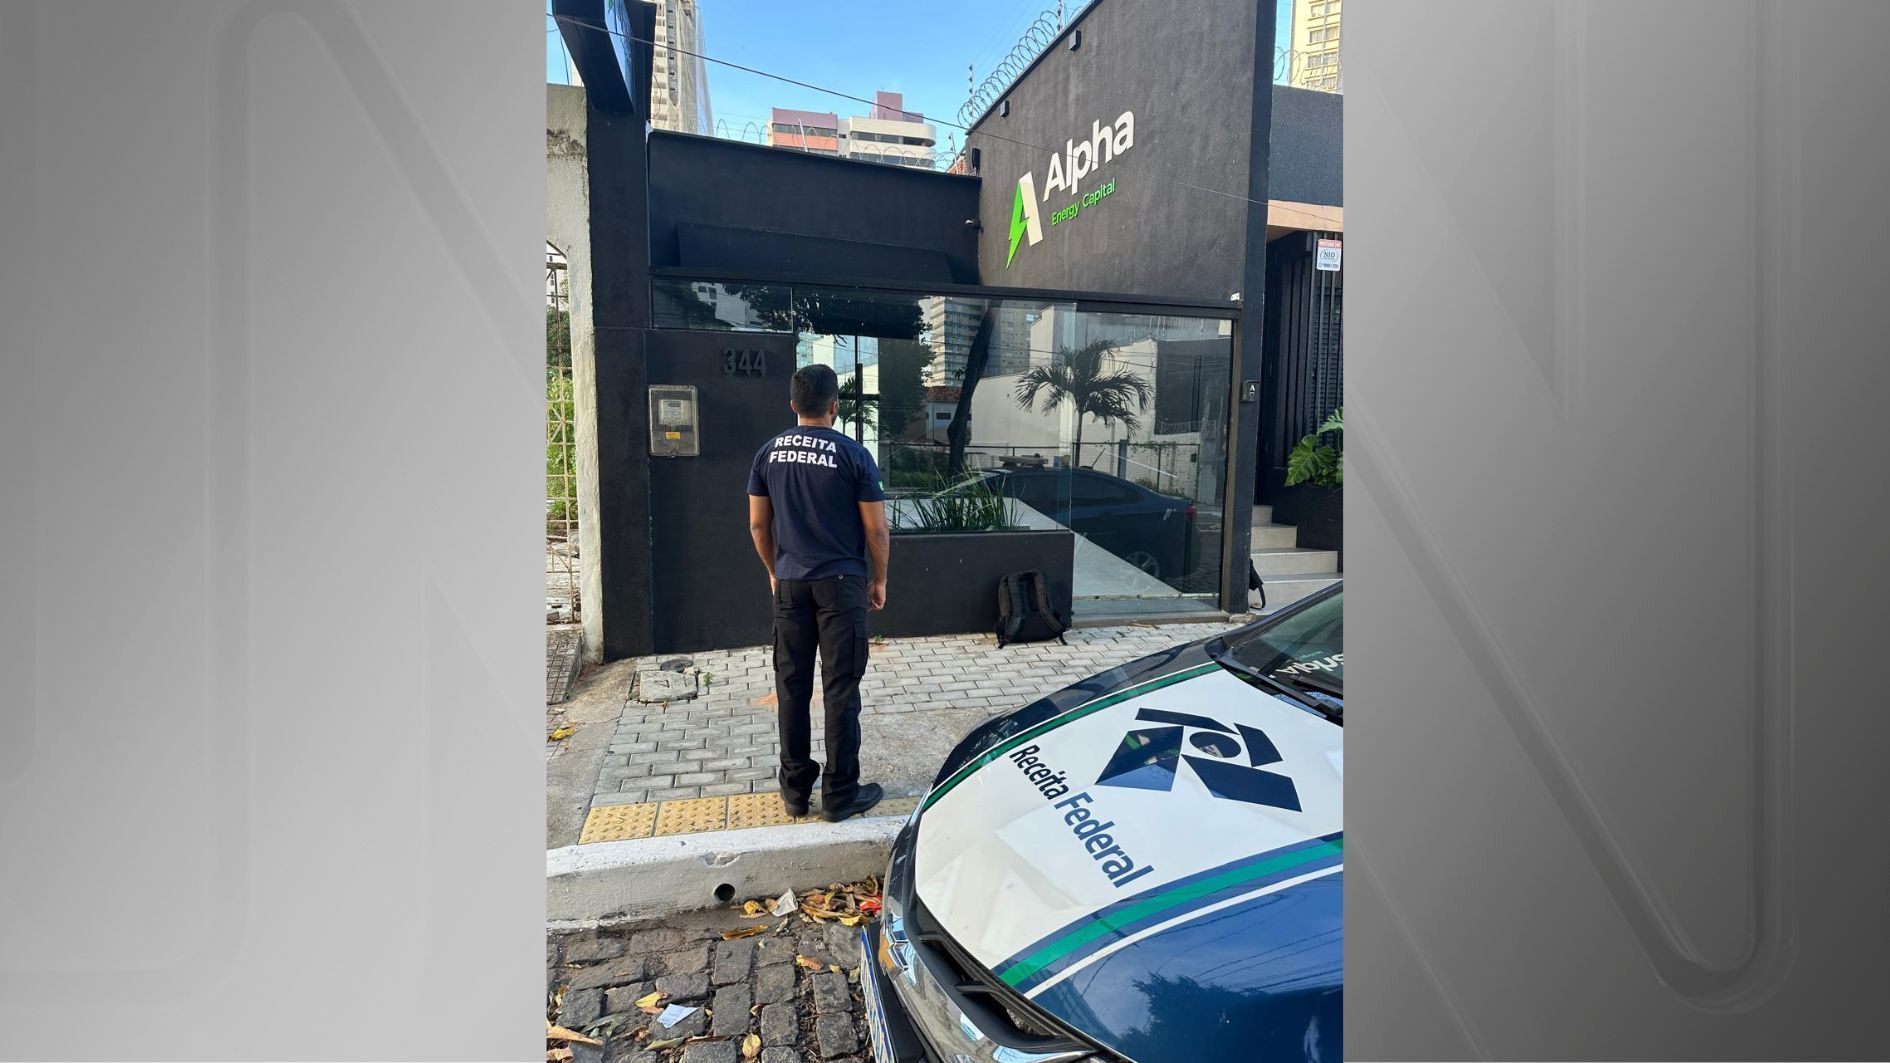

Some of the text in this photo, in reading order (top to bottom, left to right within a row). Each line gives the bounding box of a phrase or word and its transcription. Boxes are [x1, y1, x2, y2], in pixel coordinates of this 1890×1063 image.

[1043, 111, 1134, 202] Alpha
[1051, 177, 1116, 227] Energy Capital
[723, 347, 767, 376] 344
[769, 450, 838, 468] FEDERAL
[775, 434, 837, 453] RECEITA
[1009, 744, 1154, 888] Receita Federal
